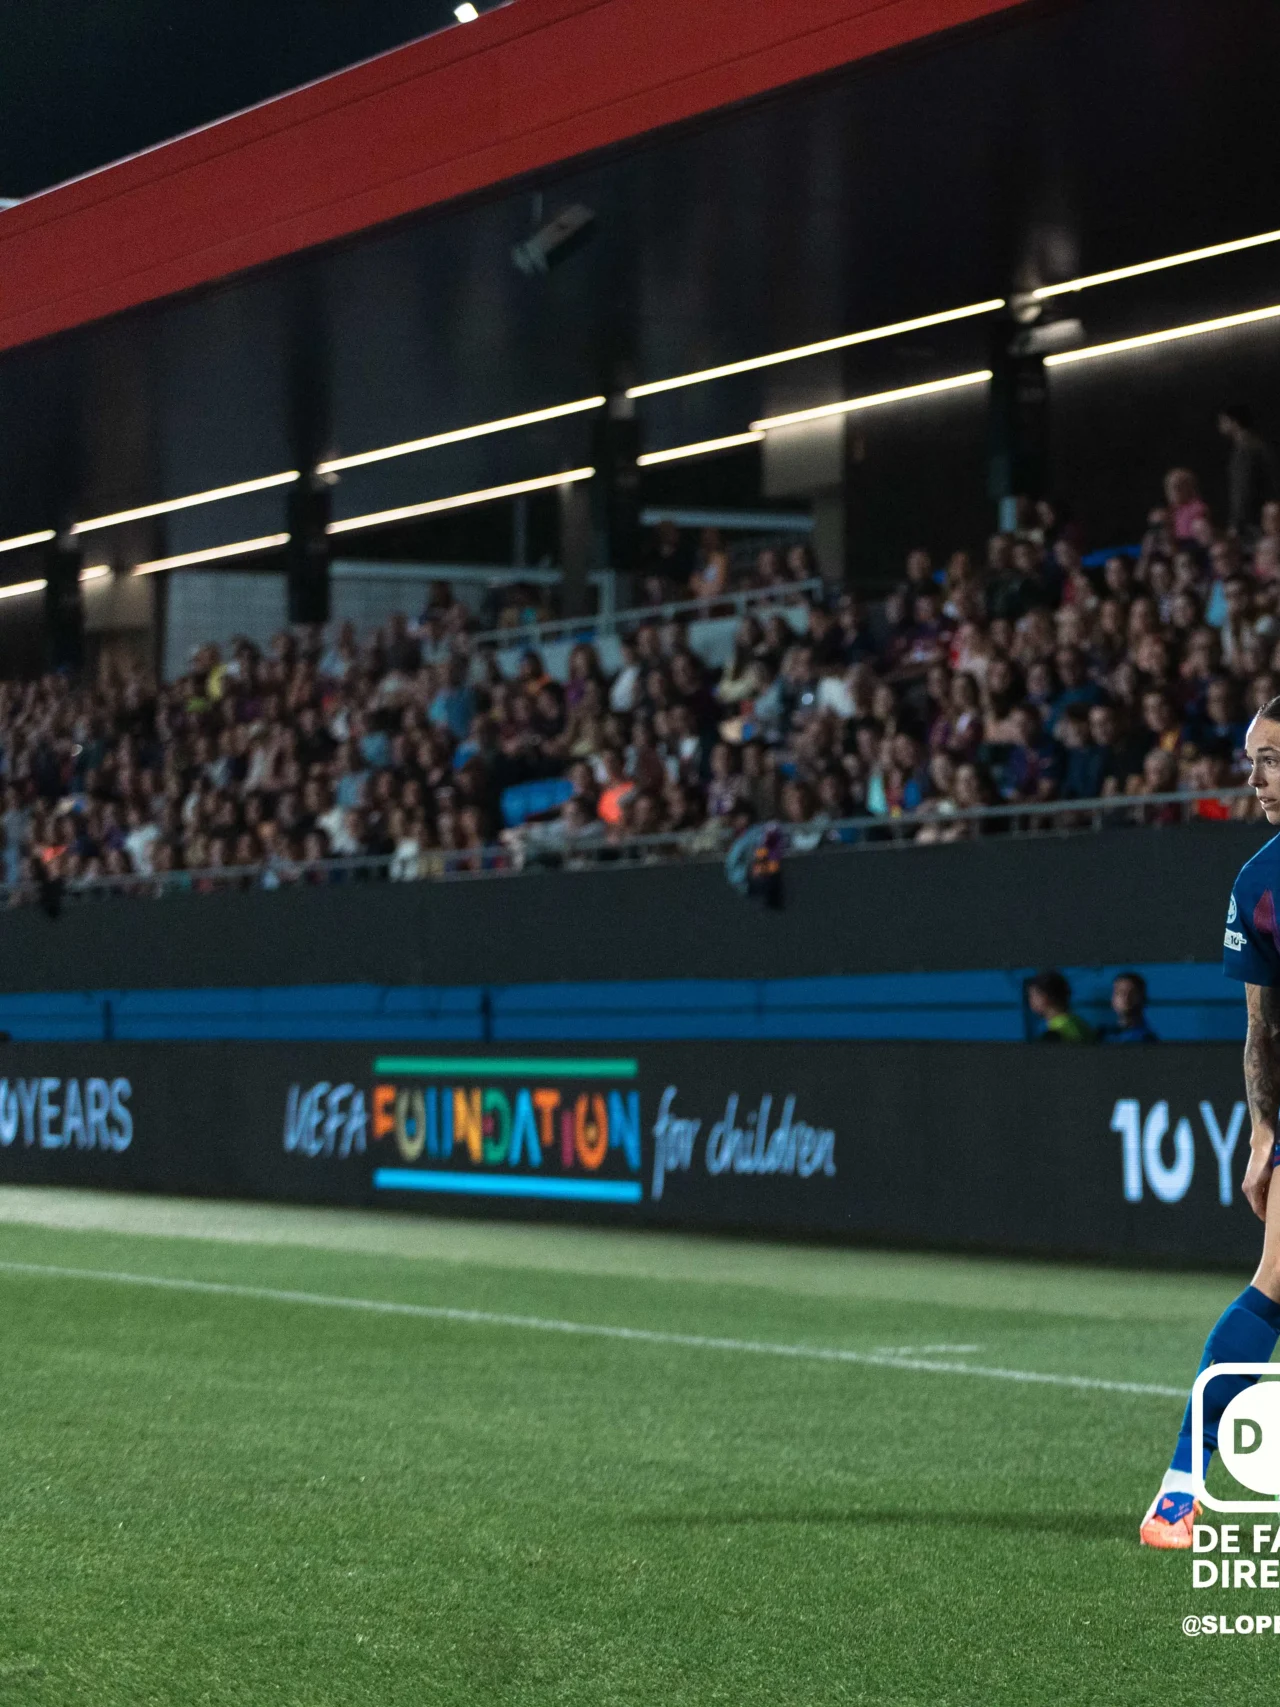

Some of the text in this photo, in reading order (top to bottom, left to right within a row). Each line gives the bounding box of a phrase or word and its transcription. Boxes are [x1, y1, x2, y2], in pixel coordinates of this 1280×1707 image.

[284, 1081, 837, 1201] UEFA FOUNDATION for children
